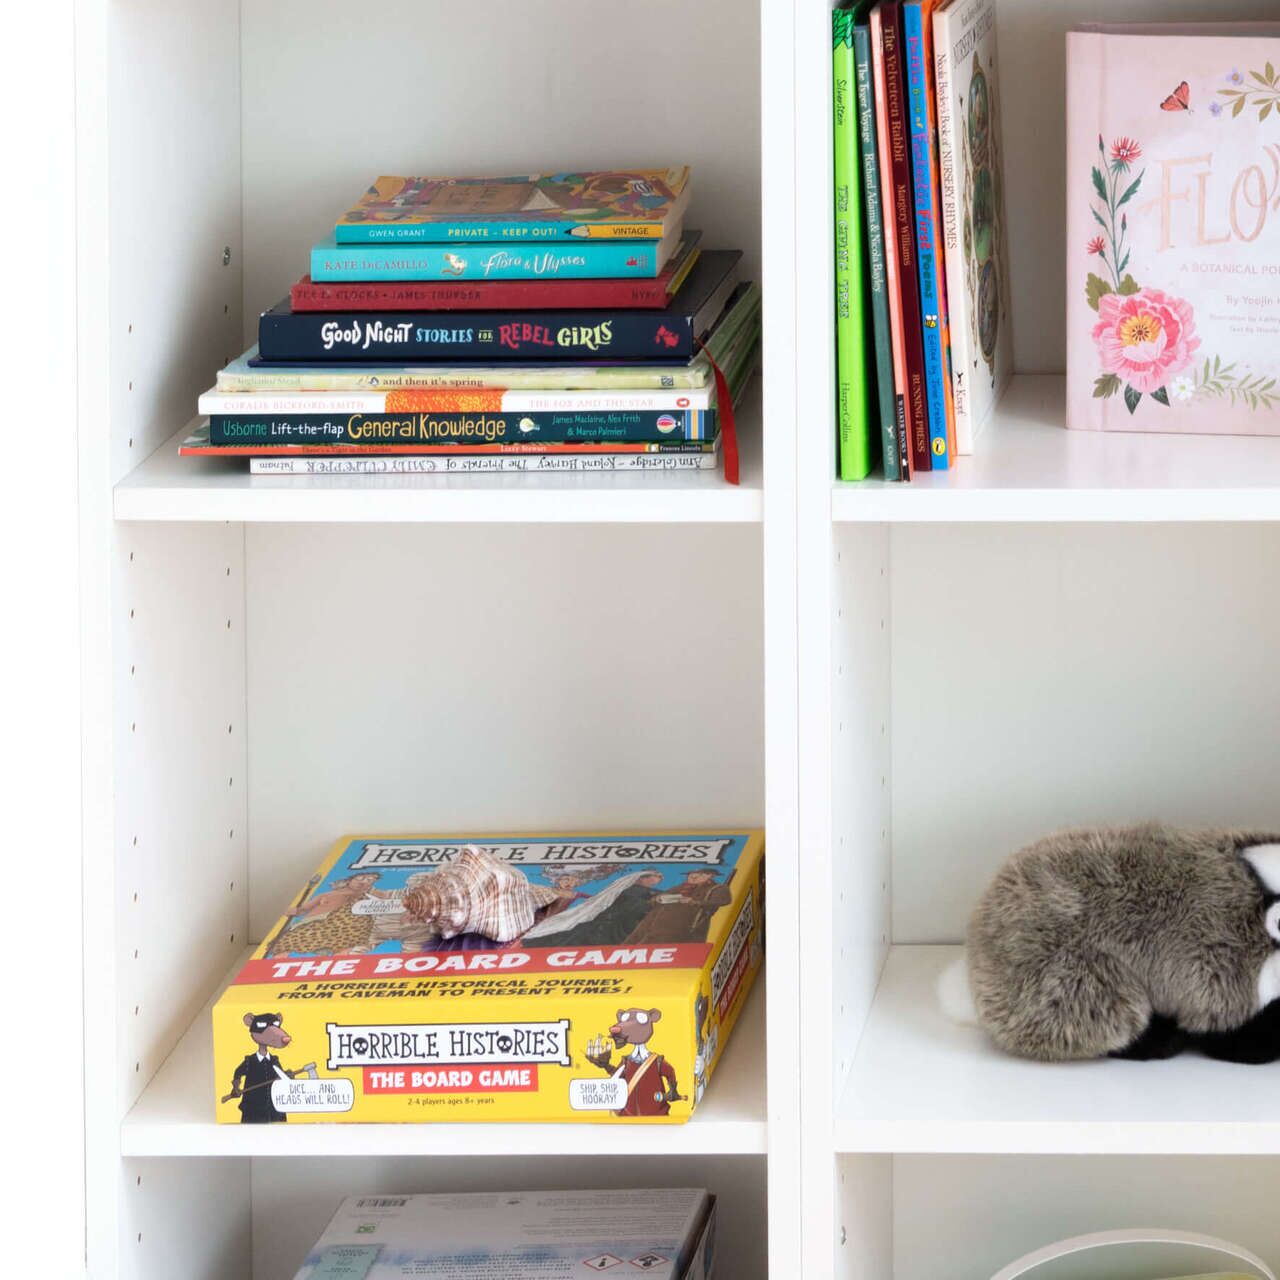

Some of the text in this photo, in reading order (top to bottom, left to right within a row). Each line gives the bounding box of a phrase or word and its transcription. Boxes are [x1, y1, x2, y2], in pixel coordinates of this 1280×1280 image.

[883, 26, 905, 162] The Velveteen Rabbit
[369, 229, 426, 237] GWEN GRANT
[448, 228, 558, 237] PRIVATE KEEP OUT!
[612, 227, 649, 235] VINTAGE
[416, 328, 474, 342] STORIES
[498, 324, 554, 347] REBEL
[223, 413, 506, 442] Usborne Lift-the-flap General Knowledge
[271, 947, 678, 979] THE BOARD GAME
[369, 1069, 532, 1088] THE BOARD GAME
